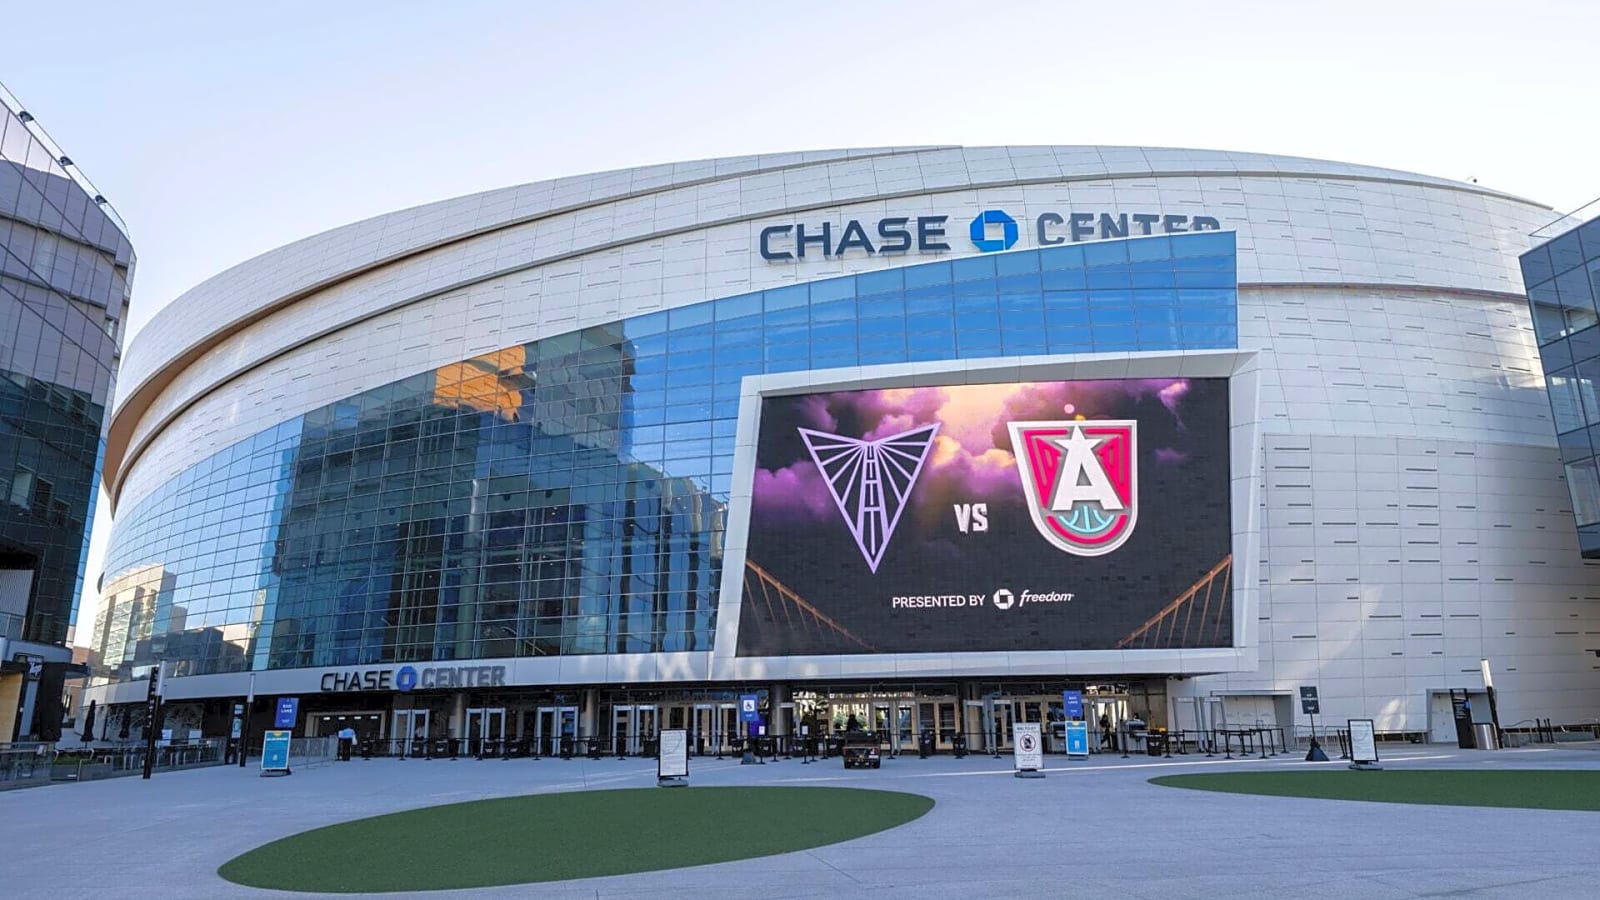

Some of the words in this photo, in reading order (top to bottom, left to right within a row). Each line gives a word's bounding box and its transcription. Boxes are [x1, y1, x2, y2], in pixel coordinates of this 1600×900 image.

[760, 215, 951, 260] CHASE
[953, 503, 989, 534] VS
[892, 595, 966, 608] PRESENTED
[969, 595, 985, 606] BY
[1019, 589, 1074, 607] freedom
[320, 670, 392, 691] CHASE
[422, 666, 506, 687] CENTER
